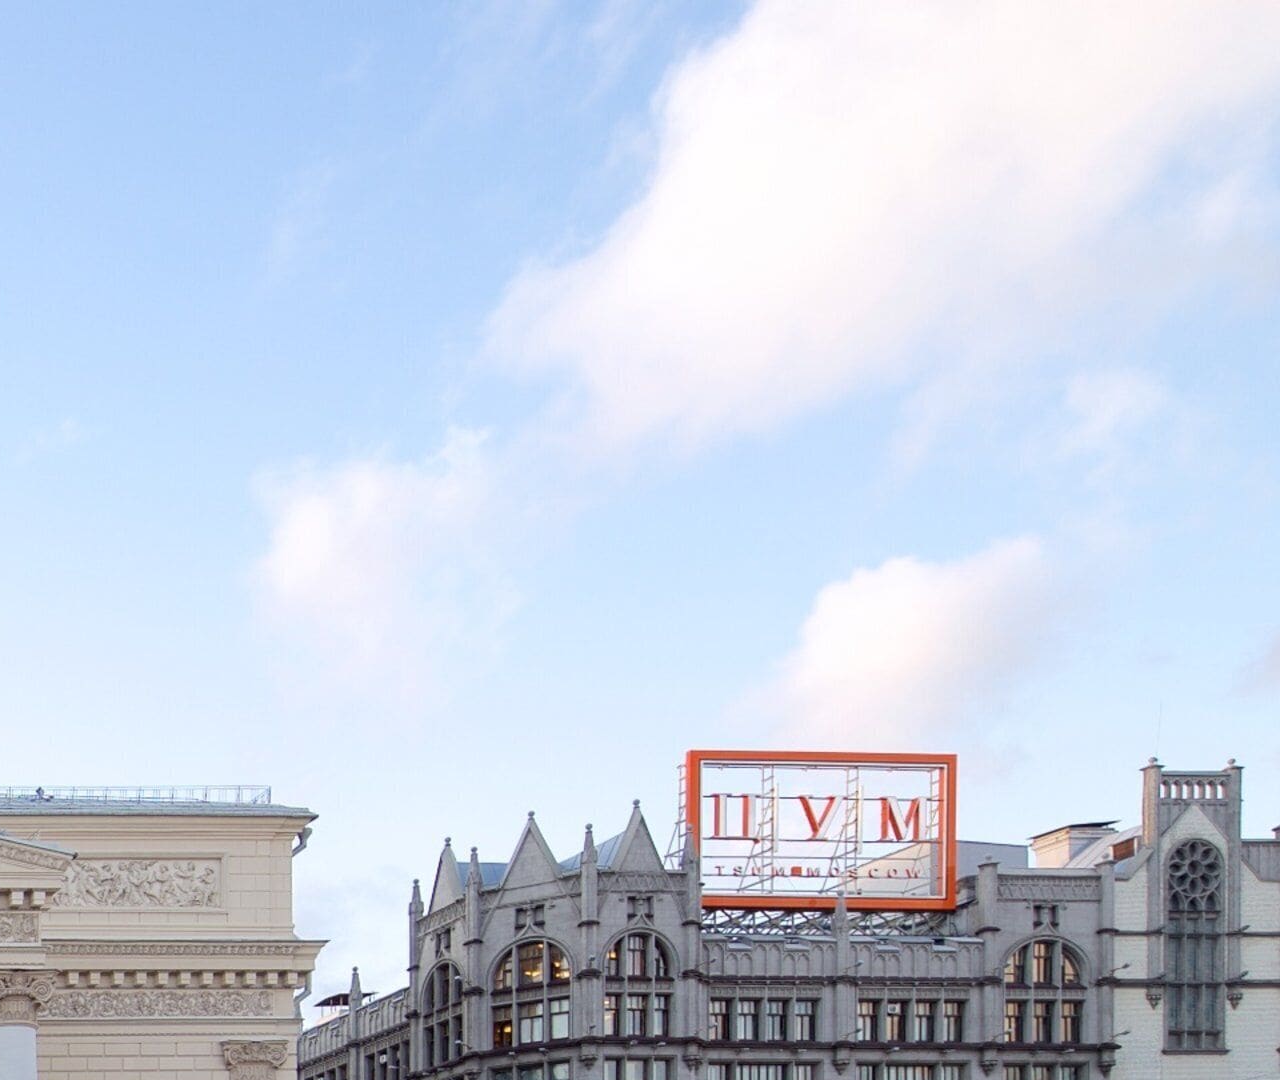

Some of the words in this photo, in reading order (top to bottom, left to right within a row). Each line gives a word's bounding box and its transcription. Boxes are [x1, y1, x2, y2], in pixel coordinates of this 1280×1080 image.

[710, 794, 928, 844] ЦУМ
[715, 866, 786, 877] TSUM
[806, 867, 921, 879] MOSCOW
